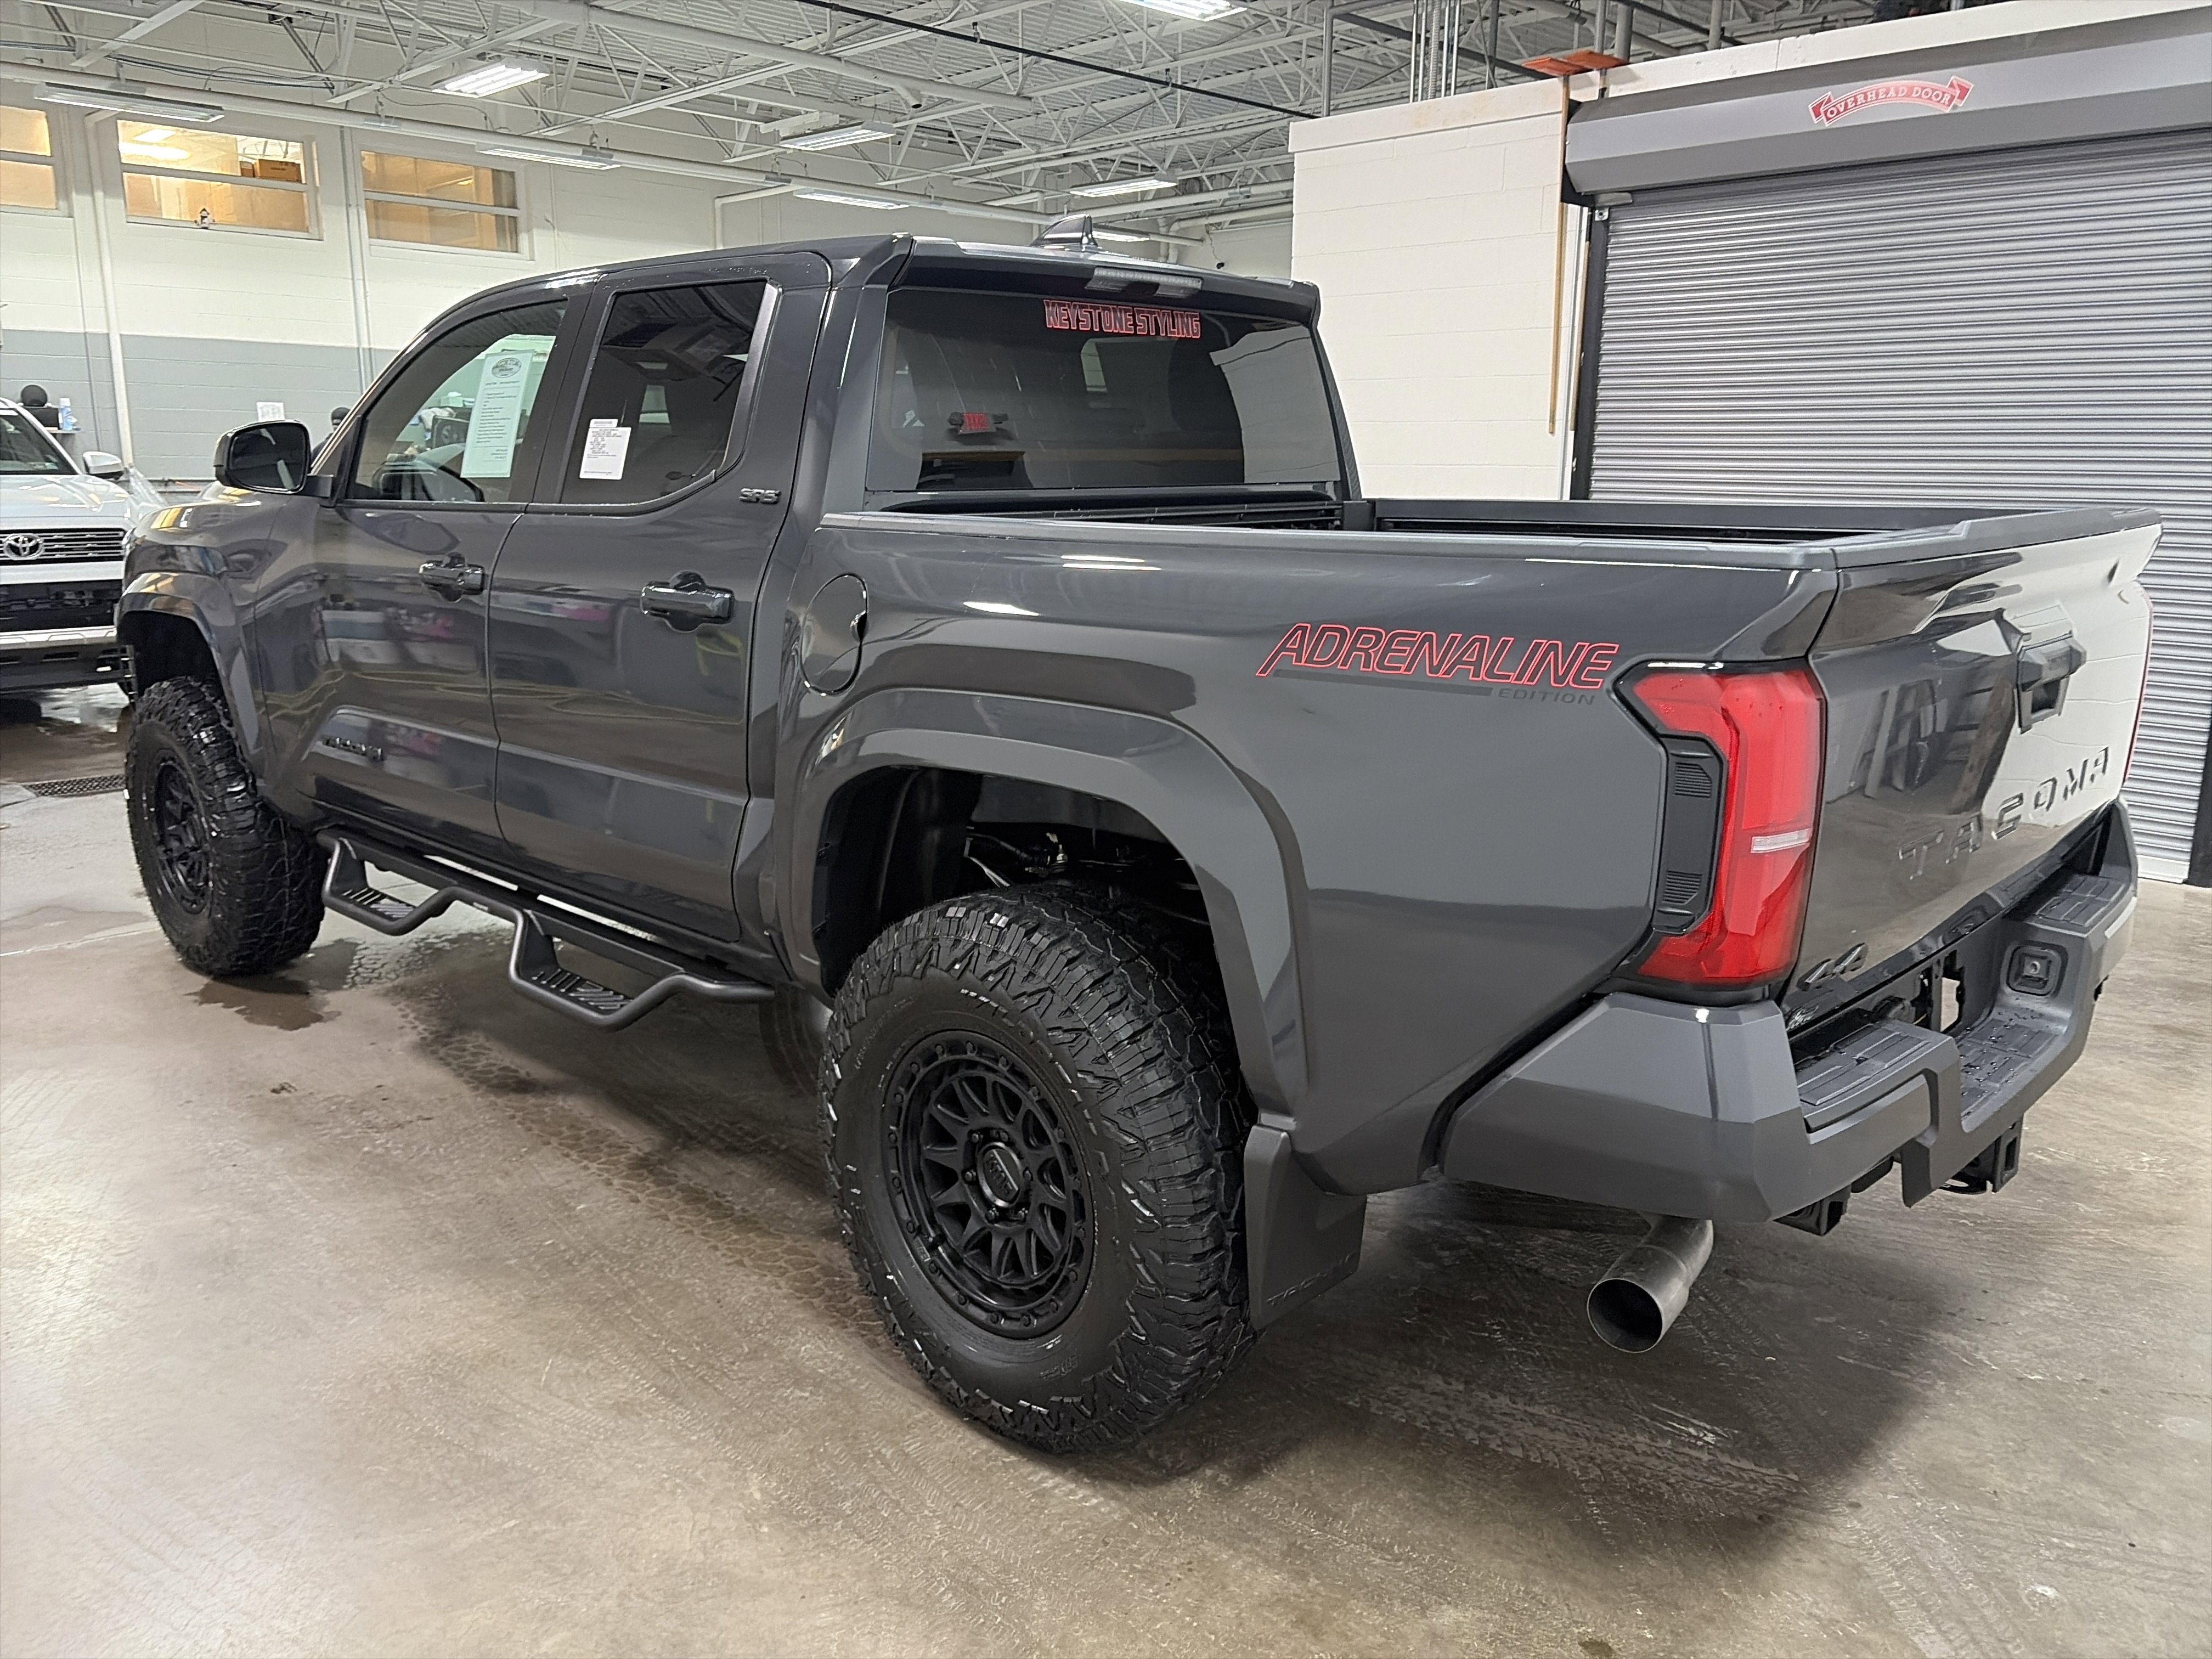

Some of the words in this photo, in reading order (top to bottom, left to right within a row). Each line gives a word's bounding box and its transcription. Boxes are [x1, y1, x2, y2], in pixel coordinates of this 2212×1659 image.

[1826, 86, 1908, 118] OVERHEAD
[1912, 87, 1949, 104] DOOR
[1043, 300, 1134, 334] KEYSTONE
[1134, 307, 1201, 338] STYLING
[1256, 623, 1619, 689] ADRENALINE
[1498, 688, 1595, 705] EDITION
[1898, 746, 2109, 880] TACOMA
